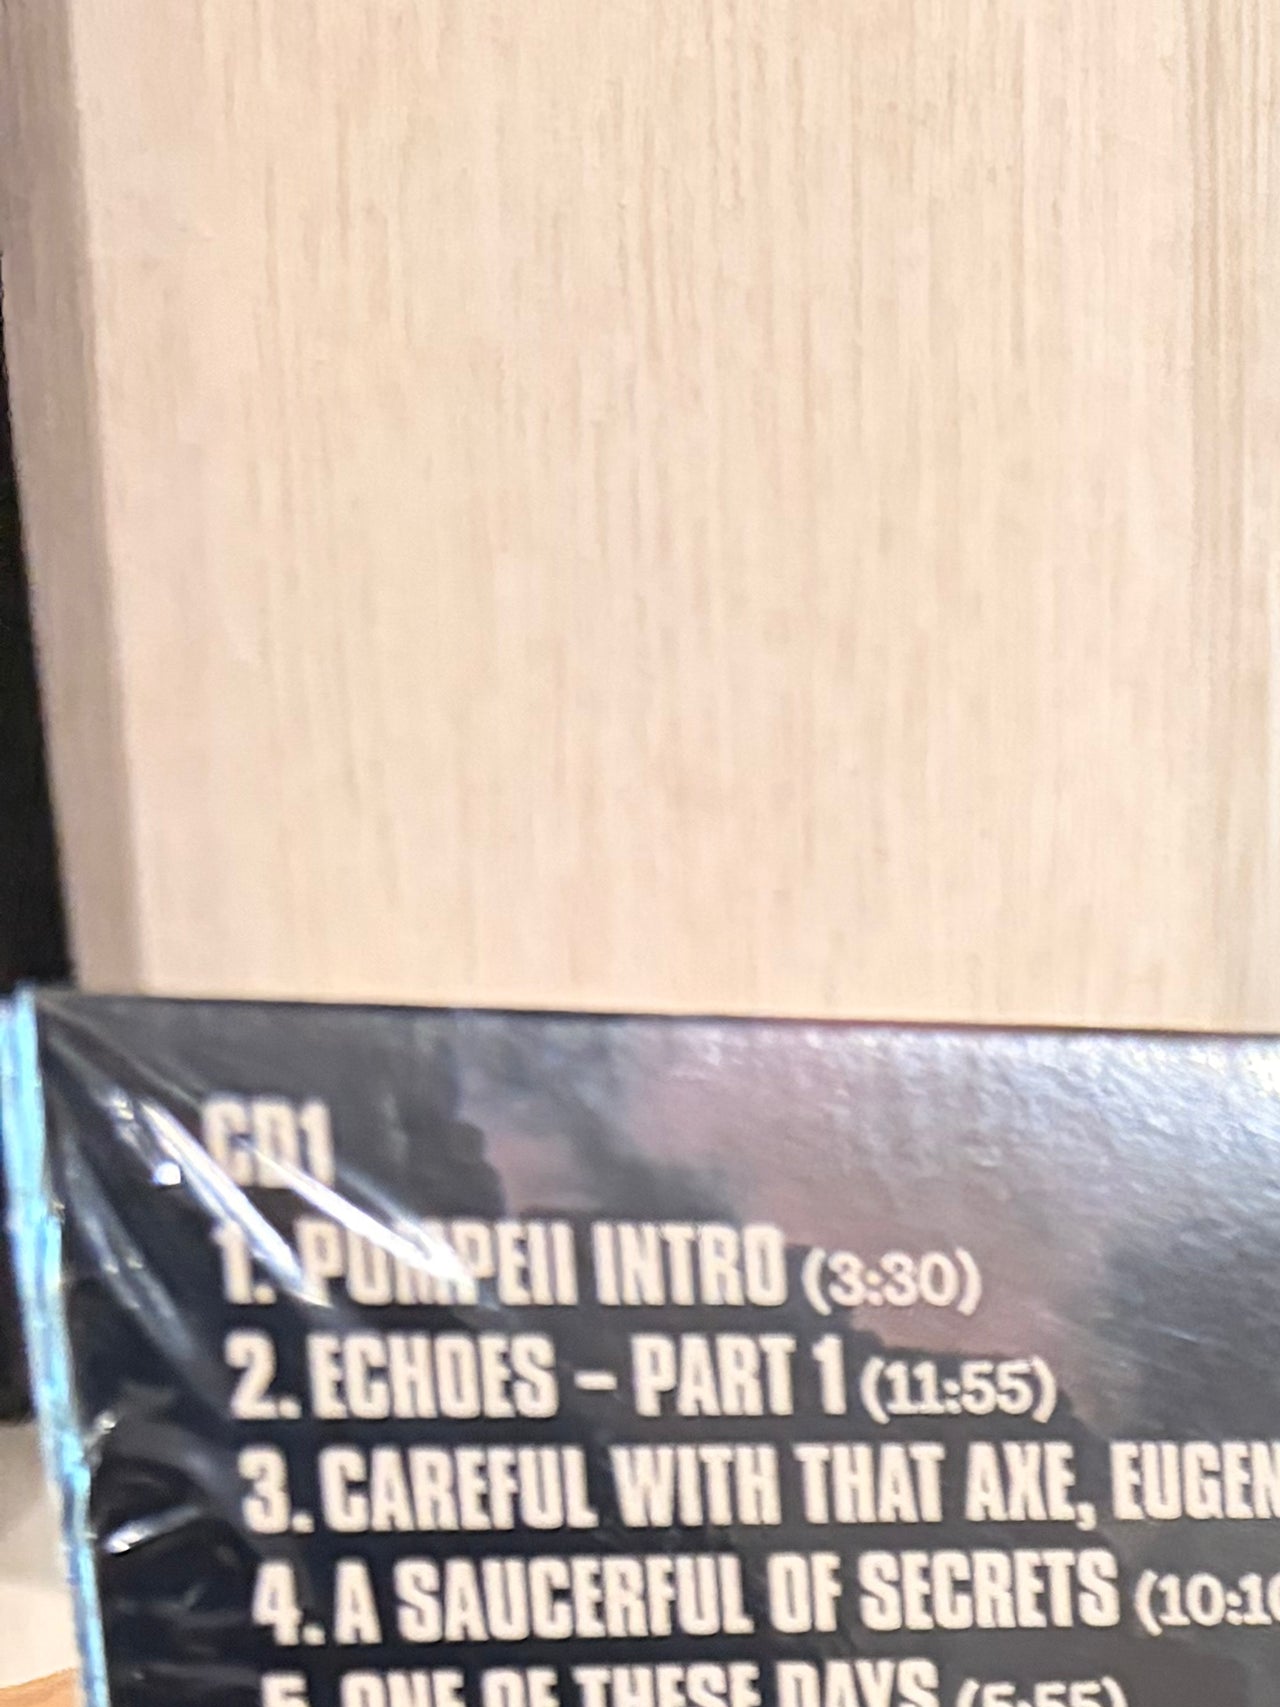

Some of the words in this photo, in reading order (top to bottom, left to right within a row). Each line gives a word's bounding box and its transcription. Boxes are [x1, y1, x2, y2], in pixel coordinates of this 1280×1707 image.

[202, 1098, 336, 1189] CD1
[213, 1224, 276, 1305] 1.
[297, 1220, 579, 1307] POMPEII
[595, 1223, 785, 1305] INTRO
[804, 1248, 981, 1314] (3:30)
[226, 1333, 300, 1418] 2.
[310, 1335, 556, 1417] ECHOES
[632, 1335, 795, 1415] PART
[813, 1335, 845, 1414] 1
[861, 1355, 1056, 1423] (11:55)
[239, 1448, 312, 1533] 3.
[321, 1447, 597, 1530] CAREFUL
[612, 1445, 780, 1526] WITH
[795, 1443, 944, 1523] THAT
[967, 1442, 1096, 1530] AXE,
[253, 1562, 323, 1644] 4.
[336, 1562, 380, 1643] A
[396, 1555, 753, 1641] SAUCERFUL
[769, 1553, 840, 1632] OF
[860, 1550, 1119, 1629] SECRETS
